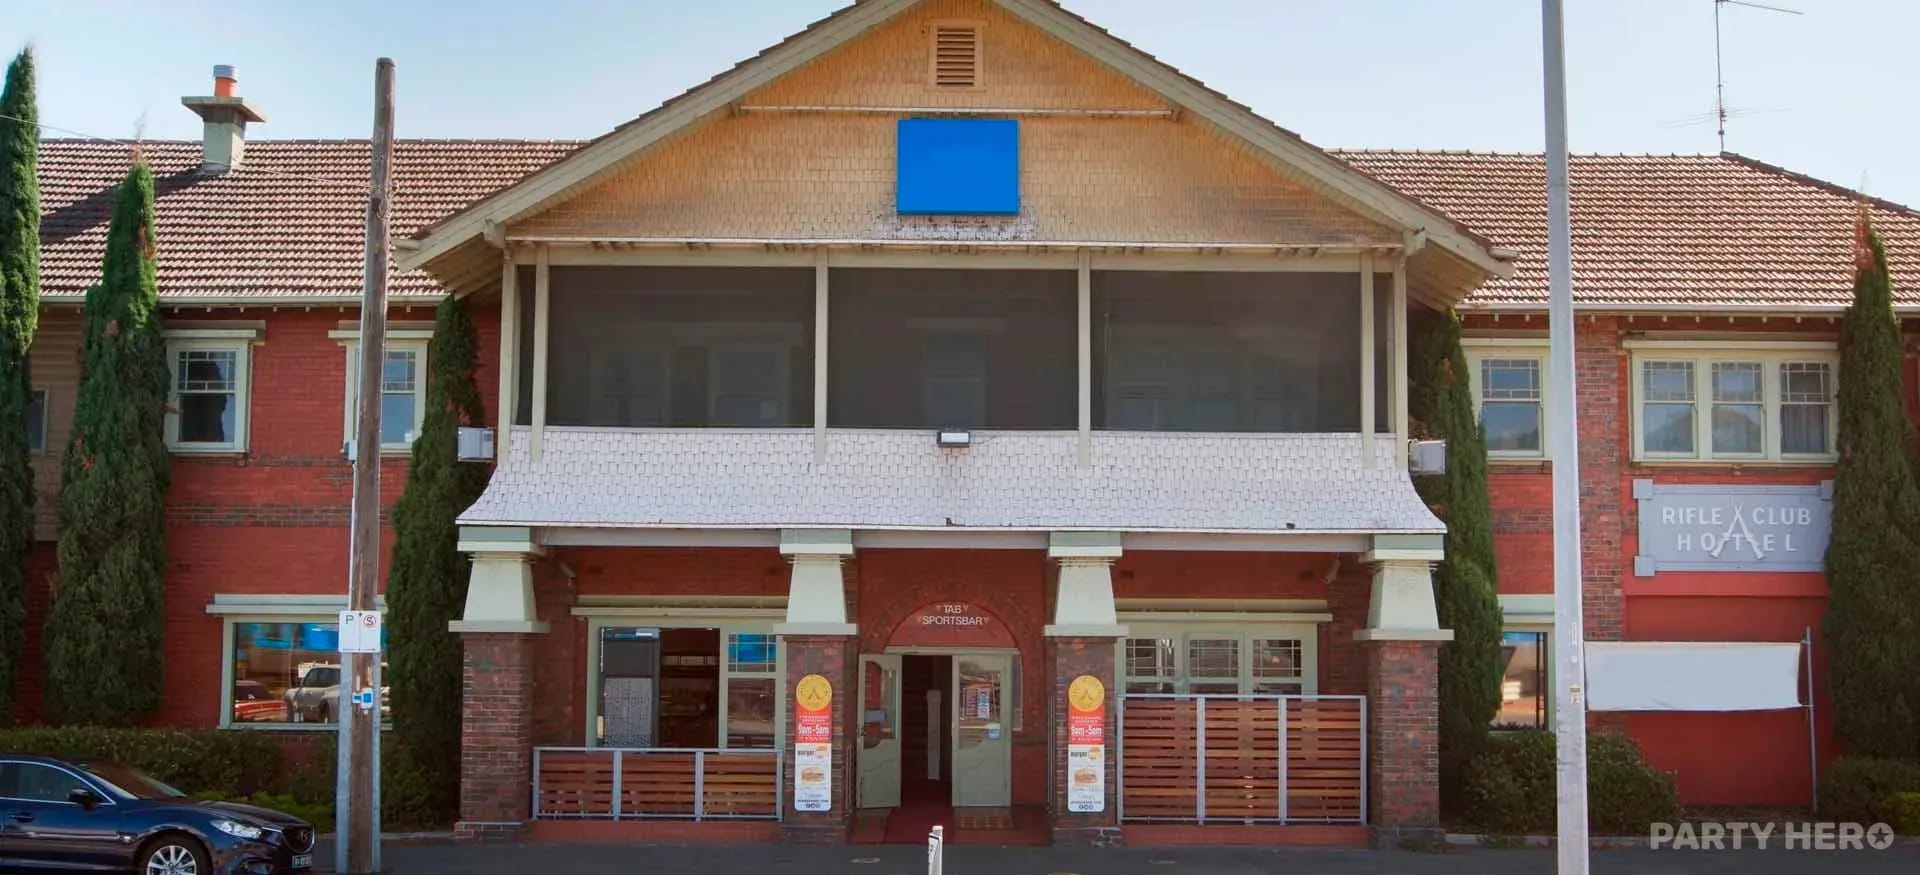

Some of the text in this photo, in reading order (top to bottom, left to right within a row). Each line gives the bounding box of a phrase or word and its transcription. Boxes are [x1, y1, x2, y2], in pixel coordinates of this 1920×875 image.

[1662, 507, 1811, 525] RIFLE CLUB
[1677, 533, 1797, 551] HOTEL
[944, 604, 961, 613] TAB
[345, 615, 354, 625] P
[922, 615, 983, 625] SPORTSBAR
